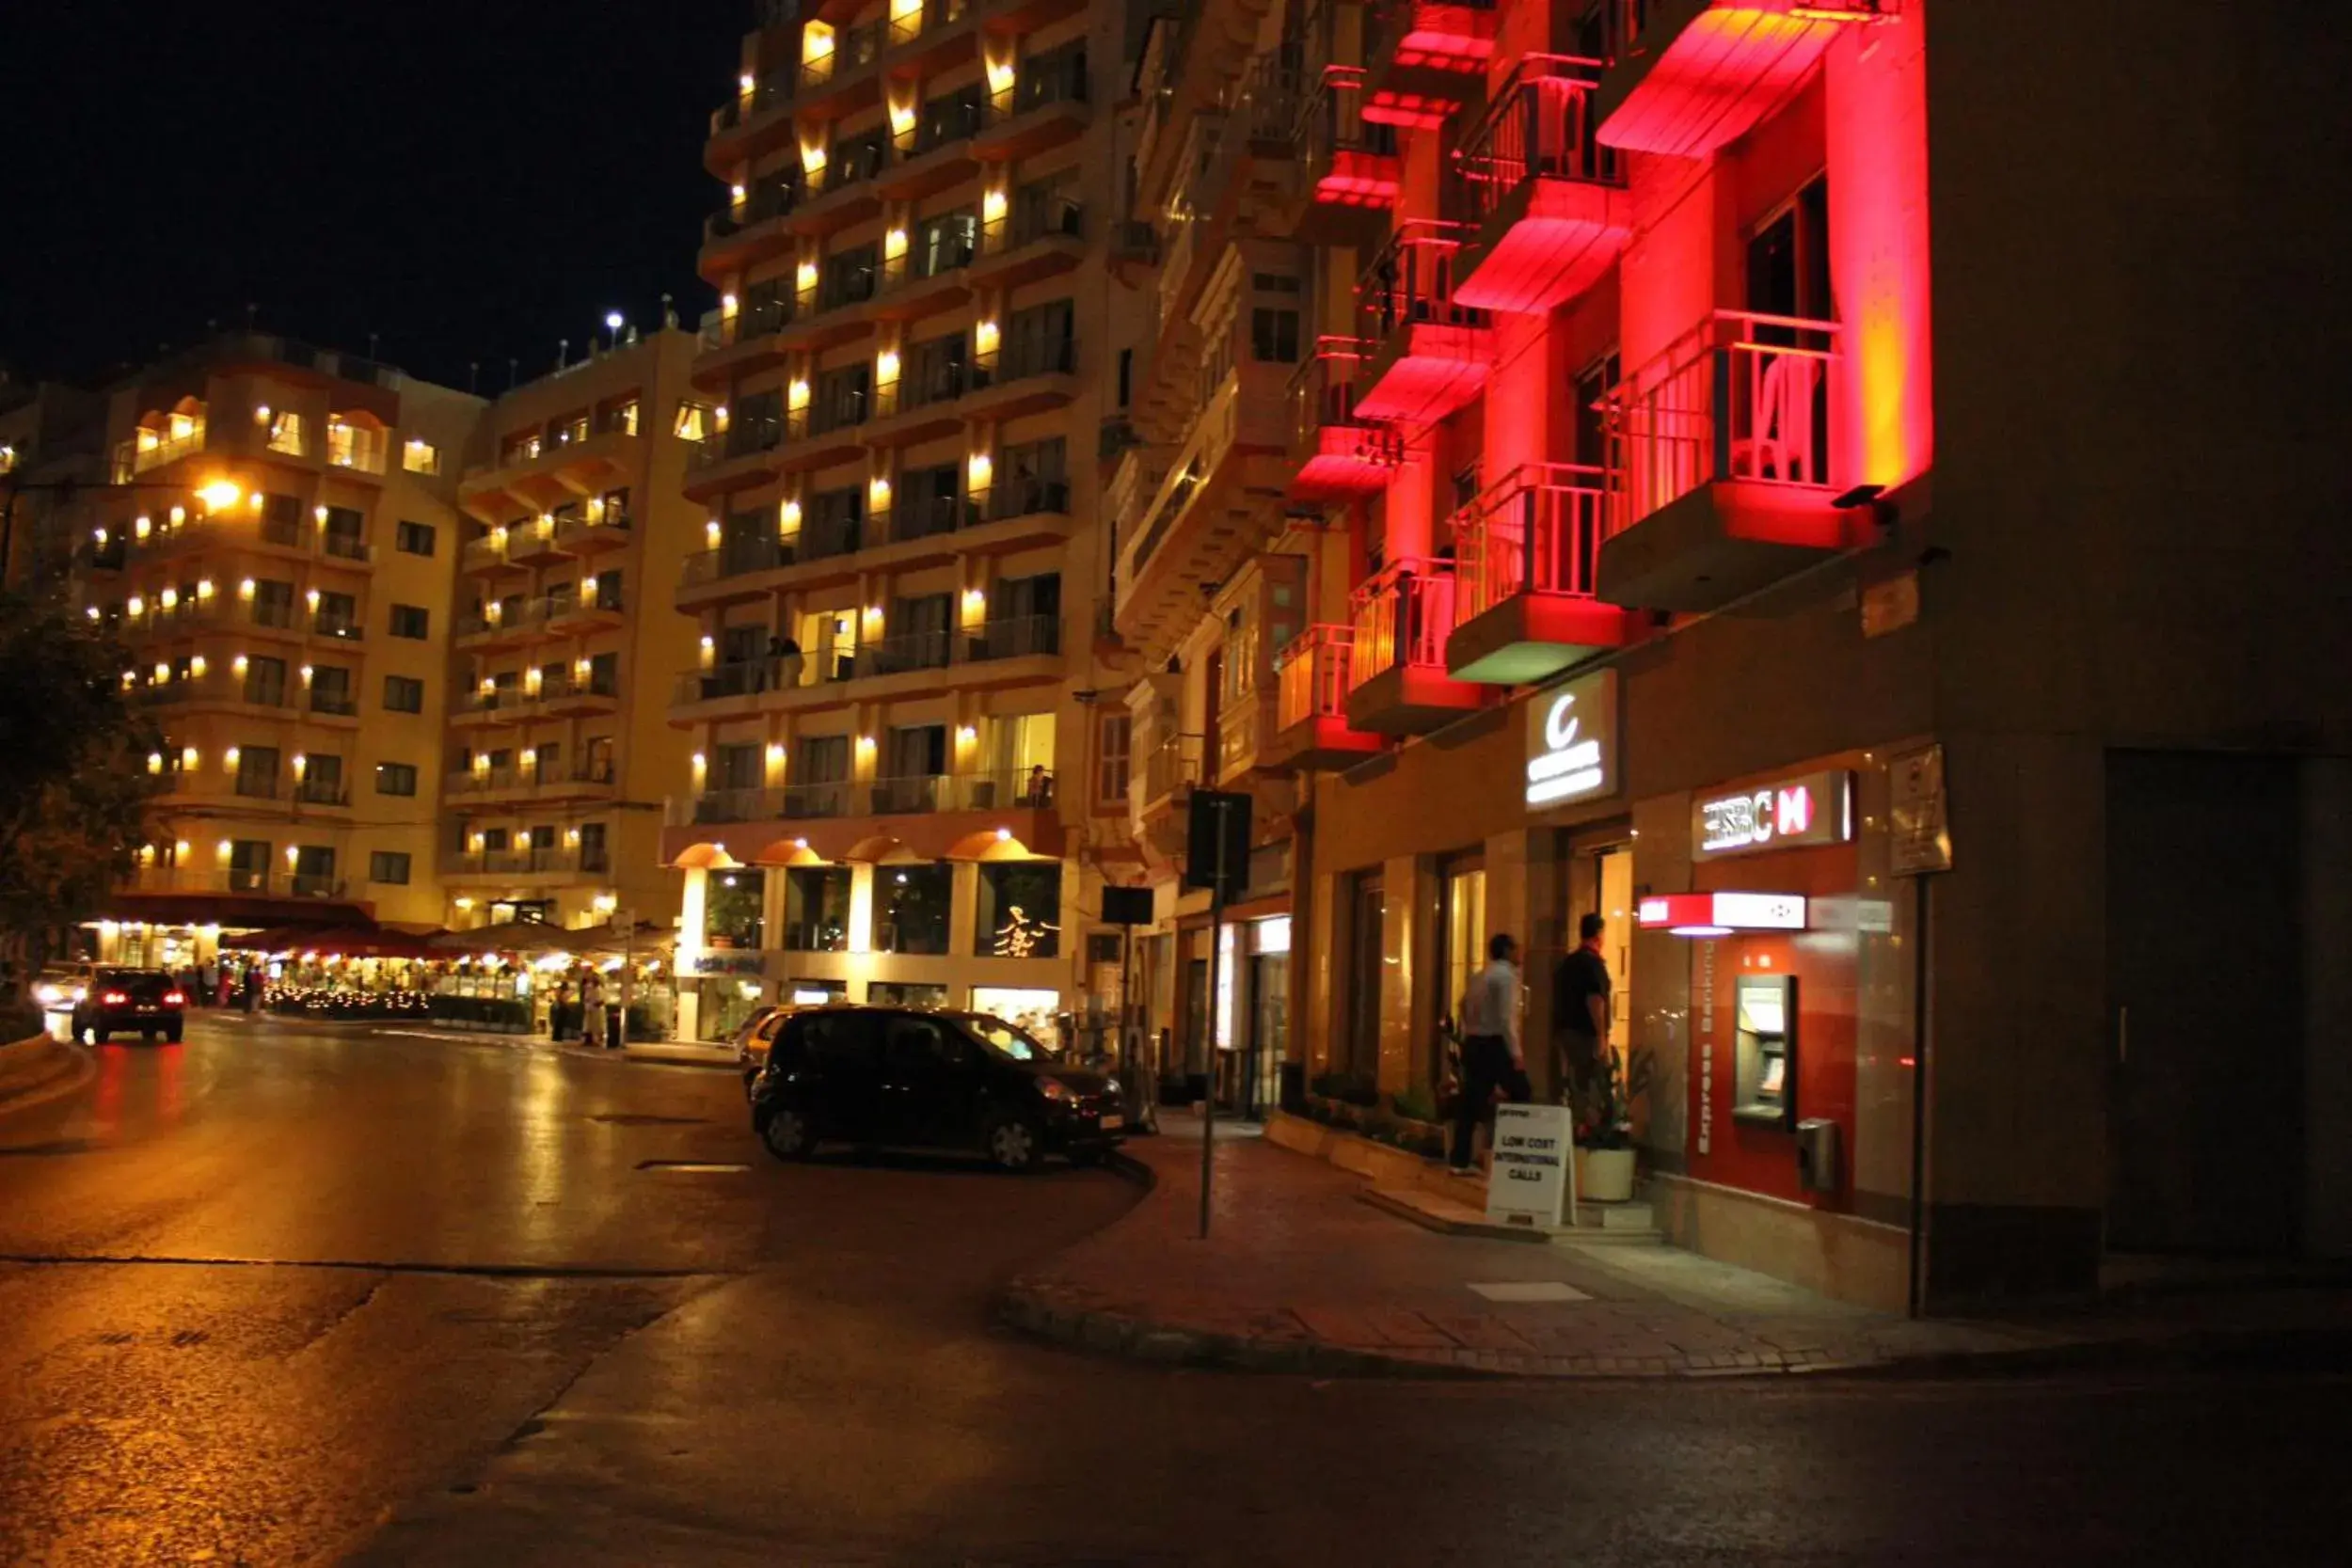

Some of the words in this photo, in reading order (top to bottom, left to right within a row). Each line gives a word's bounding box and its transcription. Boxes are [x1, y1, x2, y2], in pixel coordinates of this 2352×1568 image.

[1701, 940, 1715, 1033] Banking
[1698, 1044, 1713, 1154] Express
[1502, 1135, 1524, 1148] LOW
[1527, 1137, 1556, 1149] COST
[1494, 1151, 1559, 1166] INTERNATIONAL
[1508, 1168, 1542, 1181] CALLS
